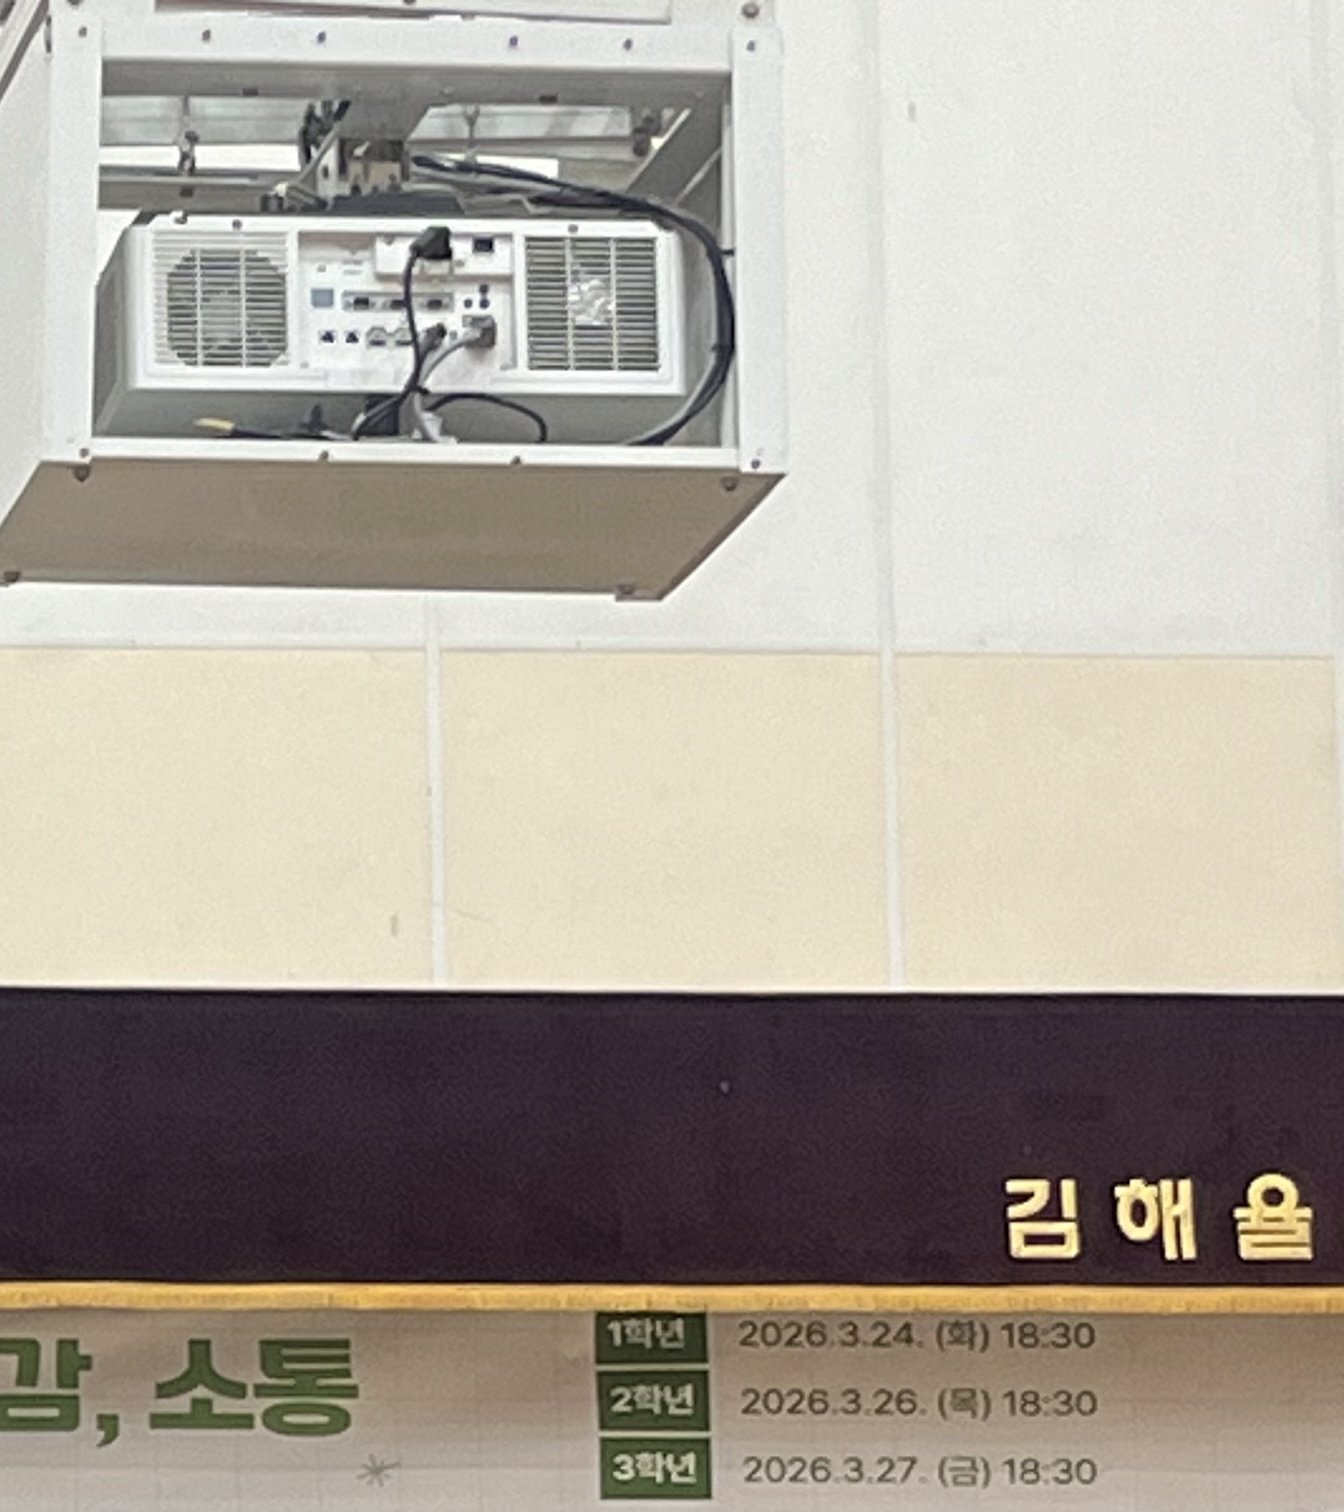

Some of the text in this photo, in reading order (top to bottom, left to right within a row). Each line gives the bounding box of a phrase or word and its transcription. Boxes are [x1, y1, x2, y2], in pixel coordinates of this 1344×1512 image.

[607, 1318, 686, 1349] 1학년
[936, 1320, 990, 1352] (화)
[1001, 1321, 1096, 1349] 18:30
[149, 1337, 359, 1438] 소통
[610, 1384, 695, 1416] 2학년
[938, 1387, 992, 1422] (목)
[1003, 1389, 1098, 1417] 18:30
[613, 1451, 698, 1484] 3학년
[938, 1455, 992, 1490] (금)
[1003, 1457, 1098, 1486] 18:30
